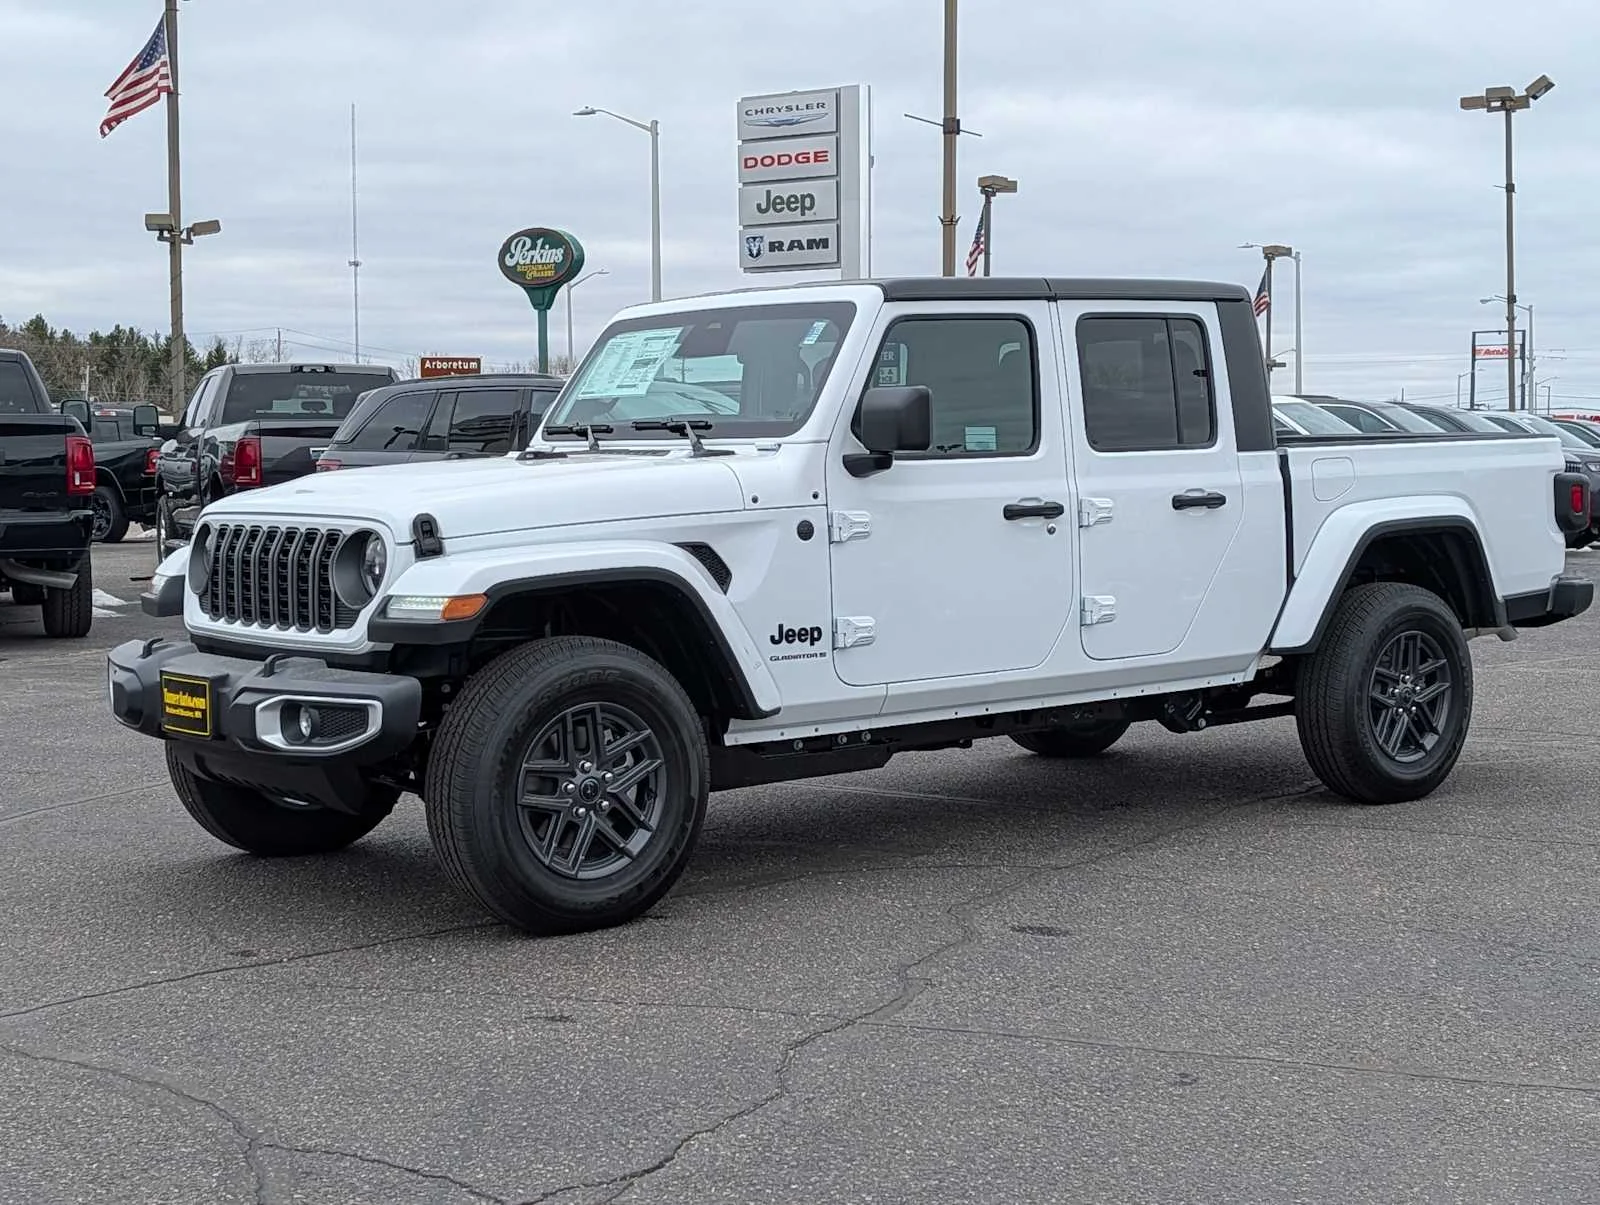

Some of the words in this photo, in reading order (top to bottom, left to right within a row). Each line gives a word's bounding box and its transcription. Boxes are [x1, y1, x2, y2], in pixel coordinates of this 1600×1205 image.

[745, 102, 826, 116] CHRYSLER
[743, 150, 829, 169] DODGE
[756, 189, 816, 216] Jeep
[505, 236, 564, 266] Perkins
[768, 237, 829, 253] RAM
[424, 359, 478, 369] Arboretum
[770, 624, 822, 646] Jeep
